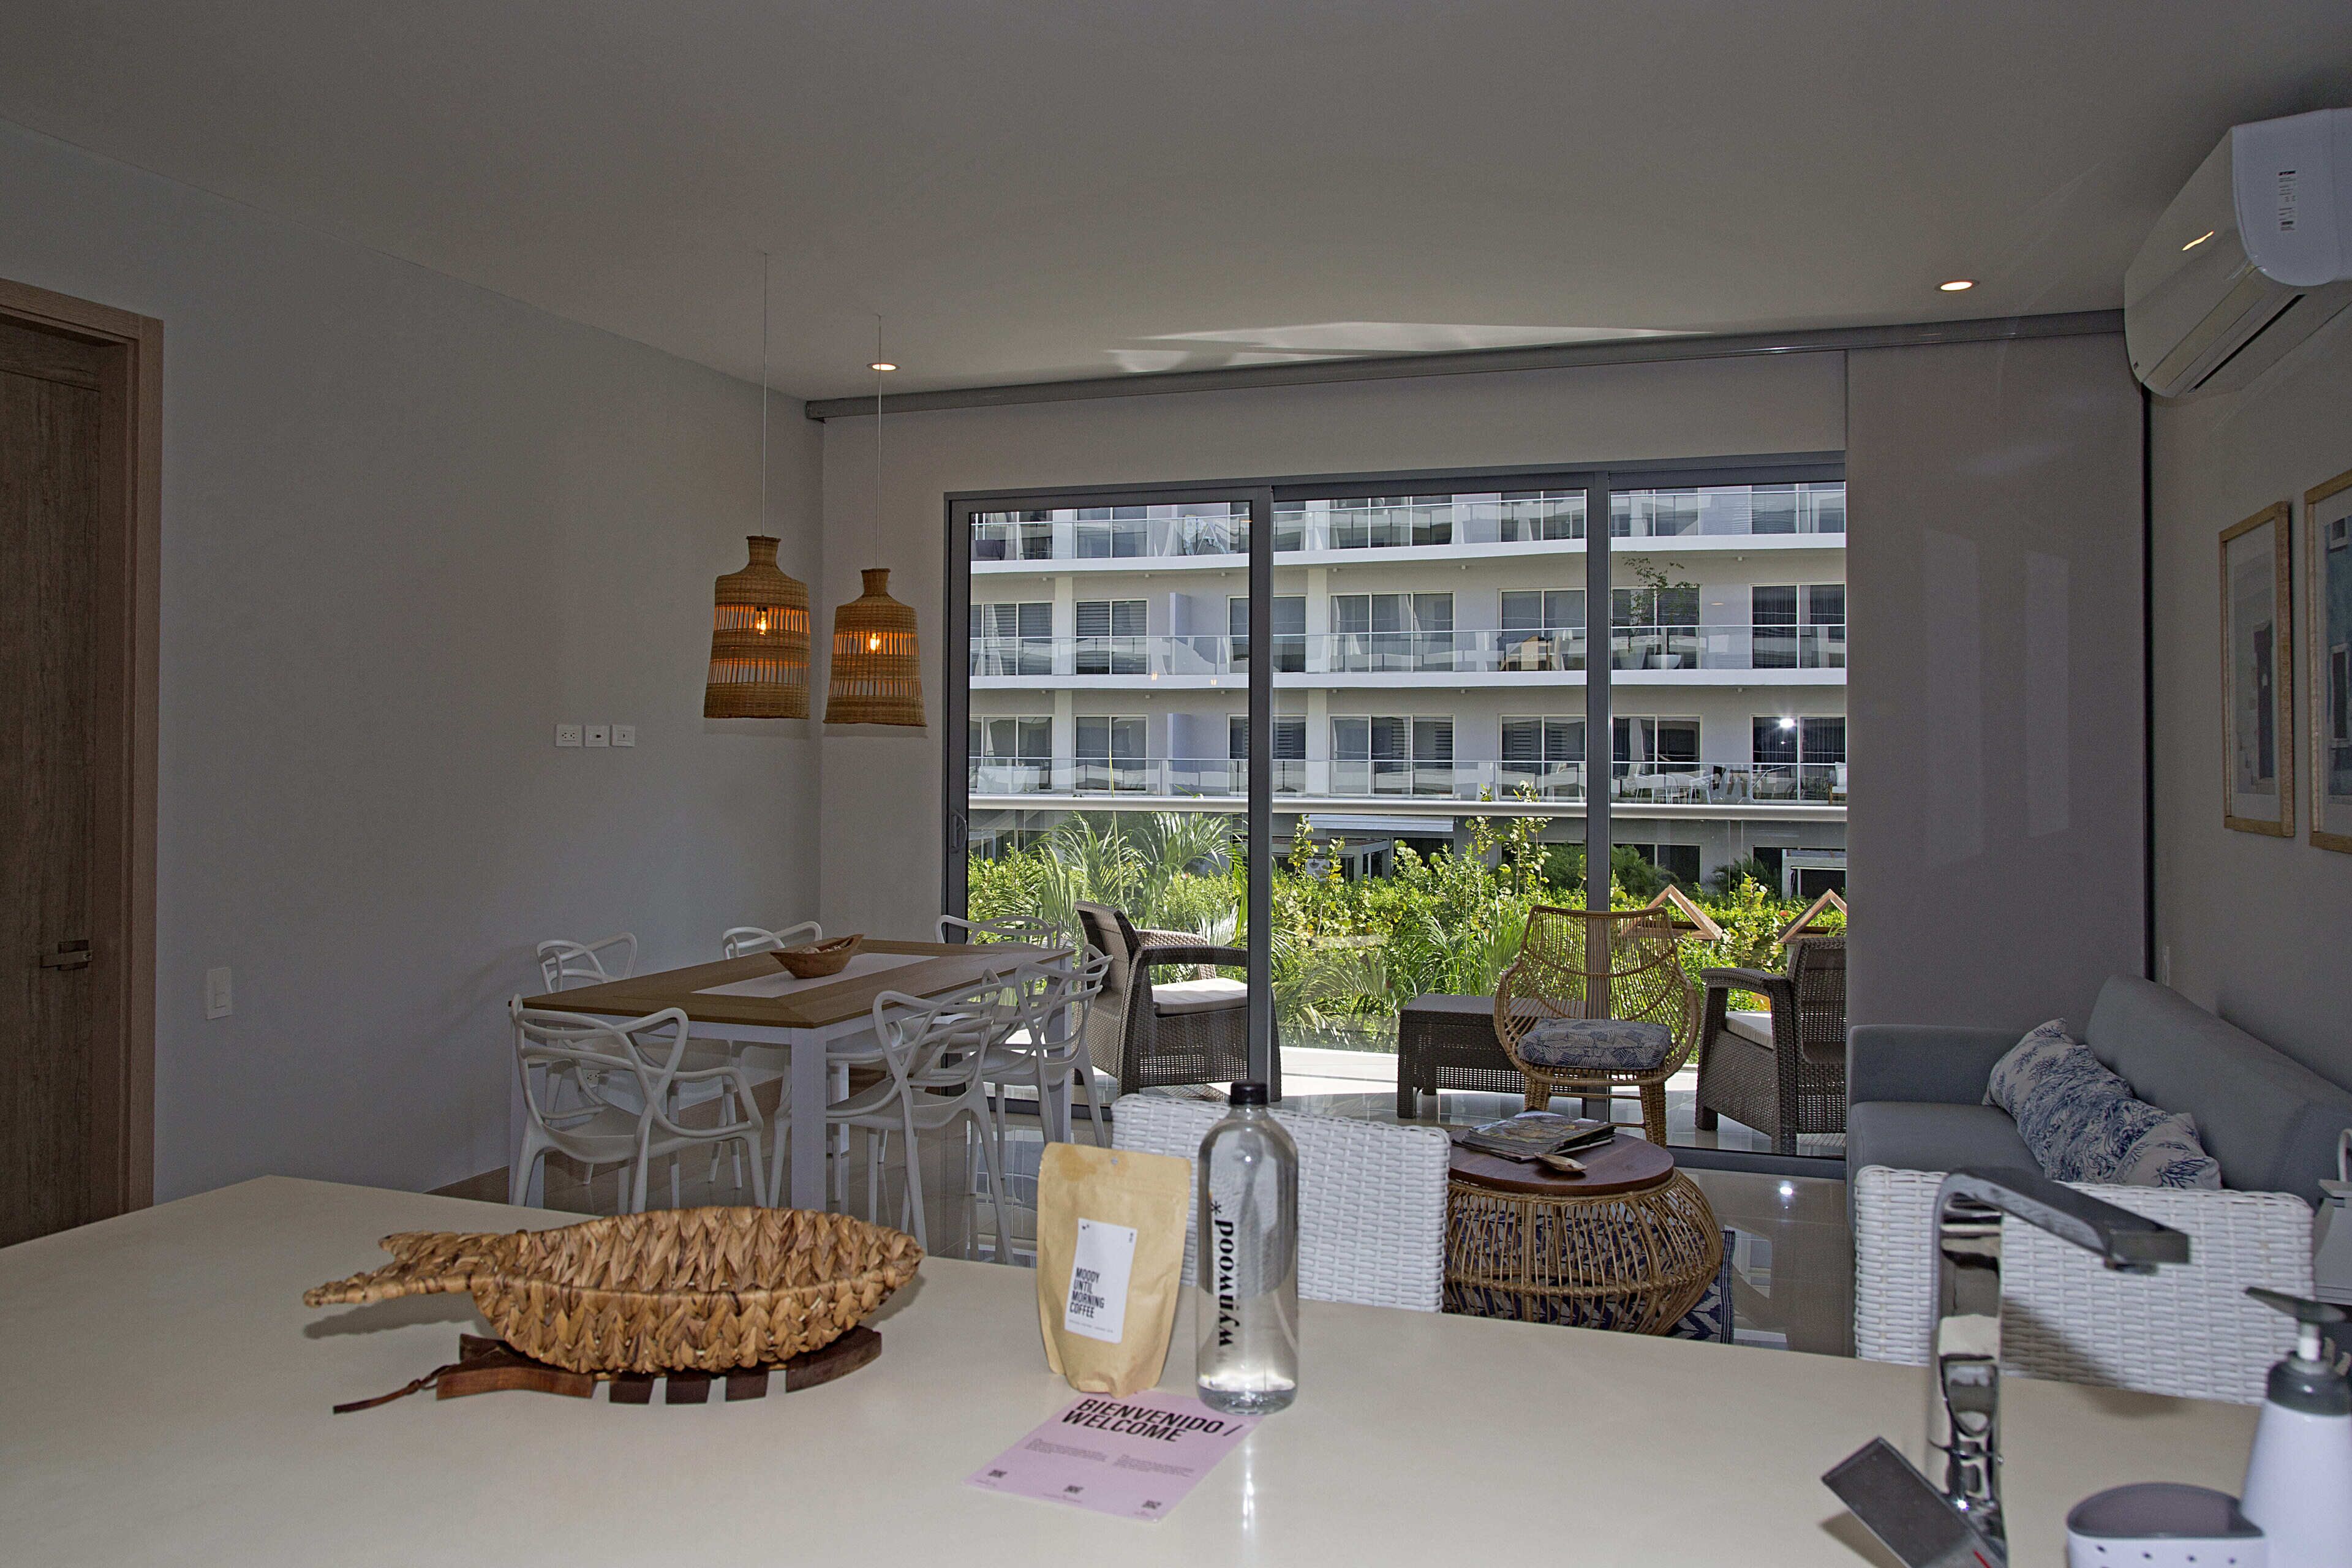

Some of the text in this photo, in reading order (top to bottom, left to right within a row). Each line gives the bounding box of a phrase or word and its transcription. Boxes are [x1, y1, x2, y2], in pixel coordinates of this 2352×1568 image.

[1076, 1267, 1101, 1284] MOODY
[1073, 1278, 1094, 1294] UNTIL
[1072, 1290, 1106, 1309] MORNING
[1069, 1302, 1095, 1319] COFFEE
[1076, 1398, 1224, 1434] BIENVENIDO
[1061, 1410, 1187, 1442] WELCOME
